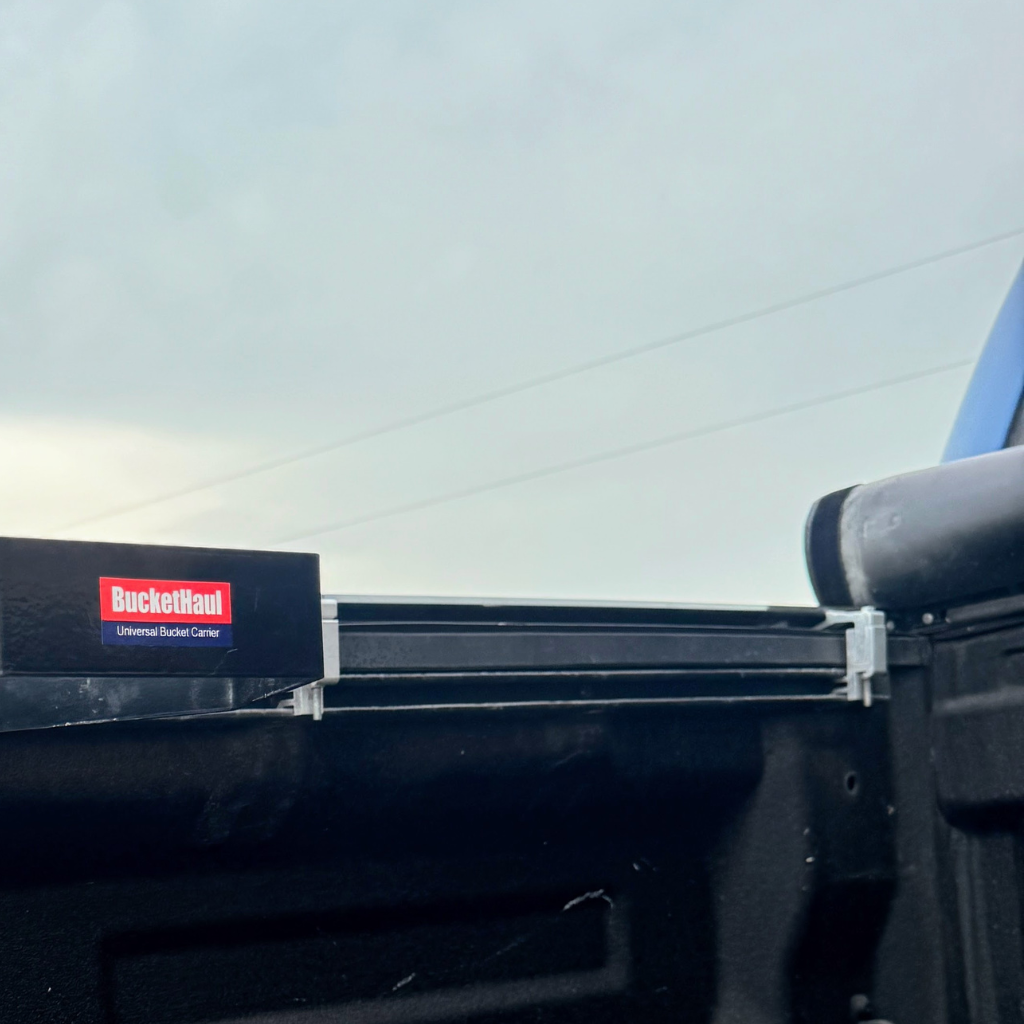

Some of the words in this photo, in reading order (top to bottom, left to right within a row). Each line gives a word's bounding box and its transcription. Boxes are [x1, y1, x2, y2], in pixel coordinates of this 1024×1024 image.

[111, 586, 222, 615] BucketHaul
[116, 626, 158, 637] Universal
[160, 627, 190, 637] Bucket
[191, 627, 220, 638] Carrier
